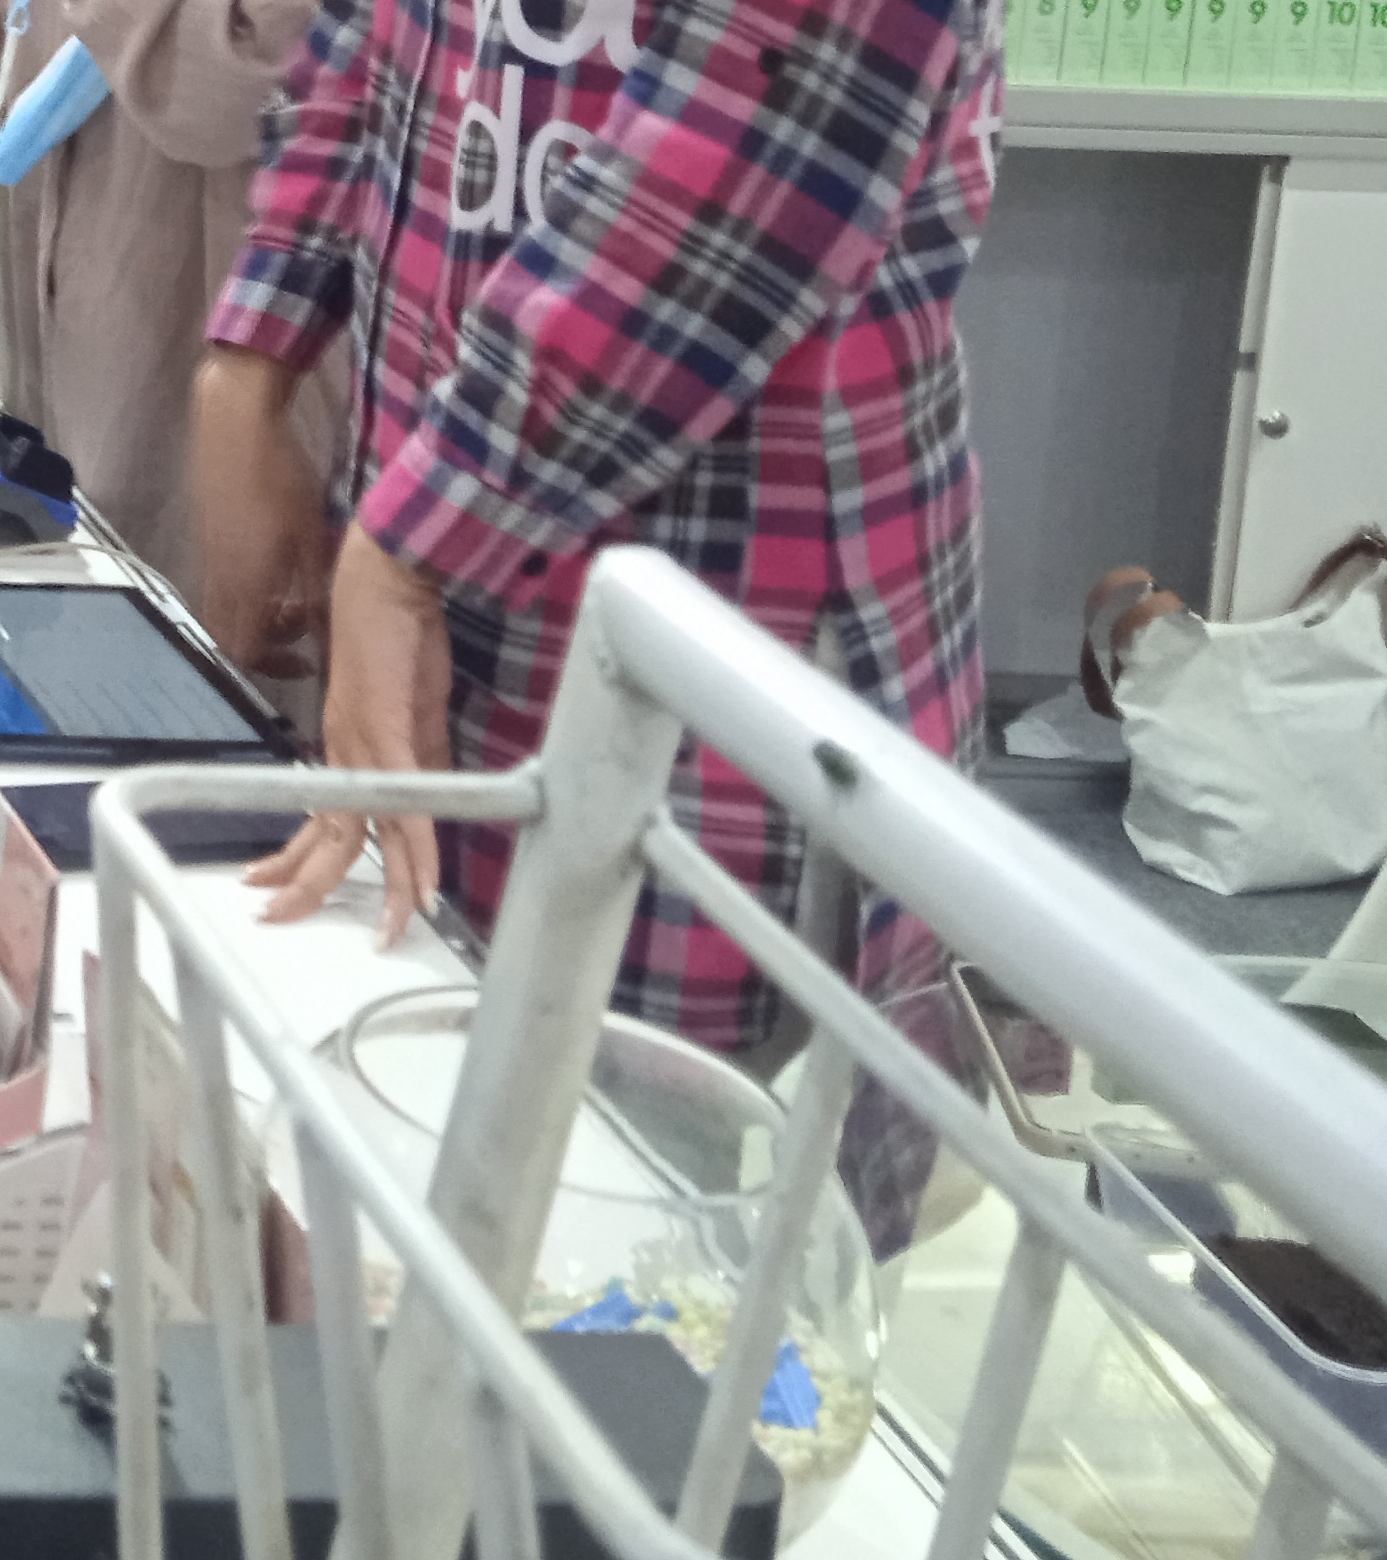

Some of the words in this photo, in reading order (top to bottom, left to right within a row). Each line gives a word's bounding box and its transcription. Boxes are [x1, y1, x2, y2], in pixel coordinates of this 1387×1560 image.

[1248, 0, 1268, 24] 9
[1290, 0, 1309, 25] 9
[1327, 0, 1357, 25] 10
